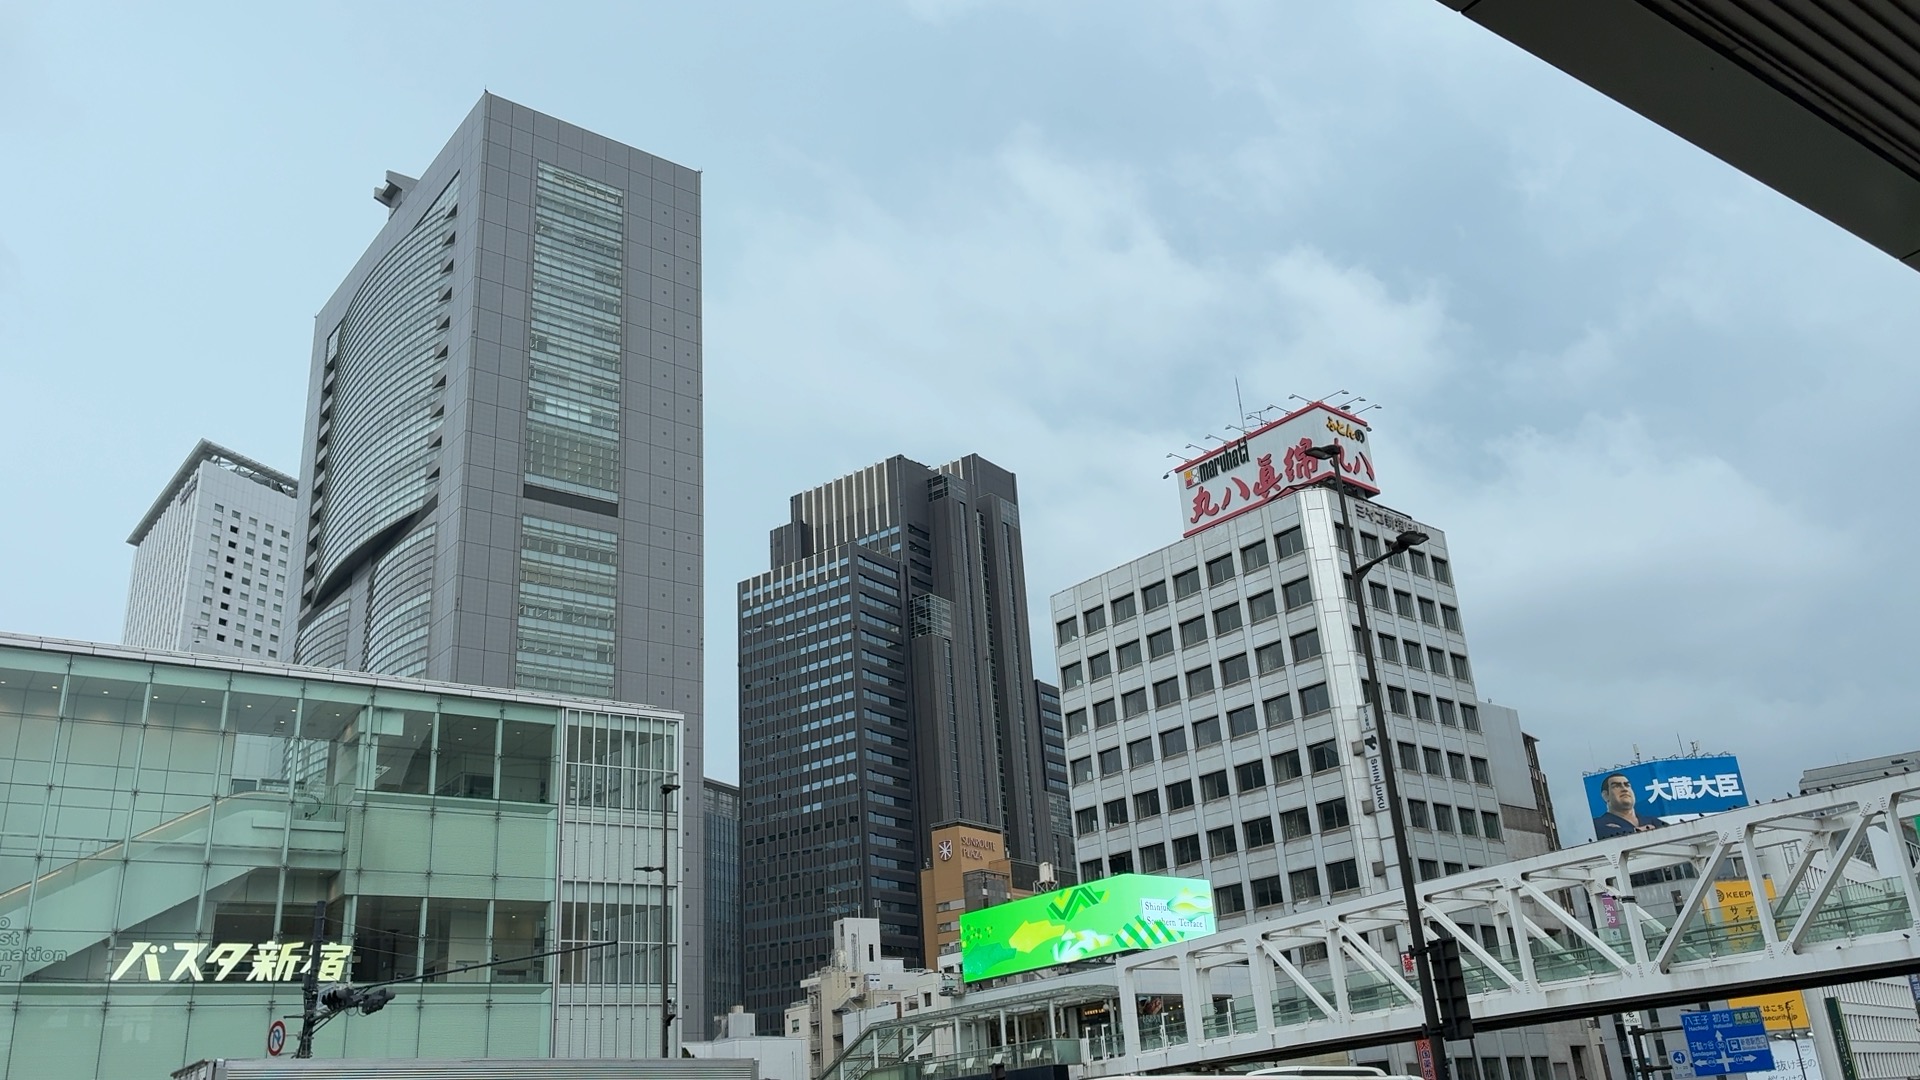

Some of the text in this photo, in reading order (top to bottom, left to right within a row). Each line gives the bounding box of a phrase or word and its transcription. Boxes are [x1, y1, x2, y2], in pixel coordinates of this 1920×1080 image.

[1645, 773, 1743, 803] 大蔵大臣
[961, 836, 996, 851] SUNROUTE
[962, 847, 984, 860] PLAZA
[110, 941, 352, 982] バスタ新宿
[1684, 1014, 1709, 1026] 八王子
